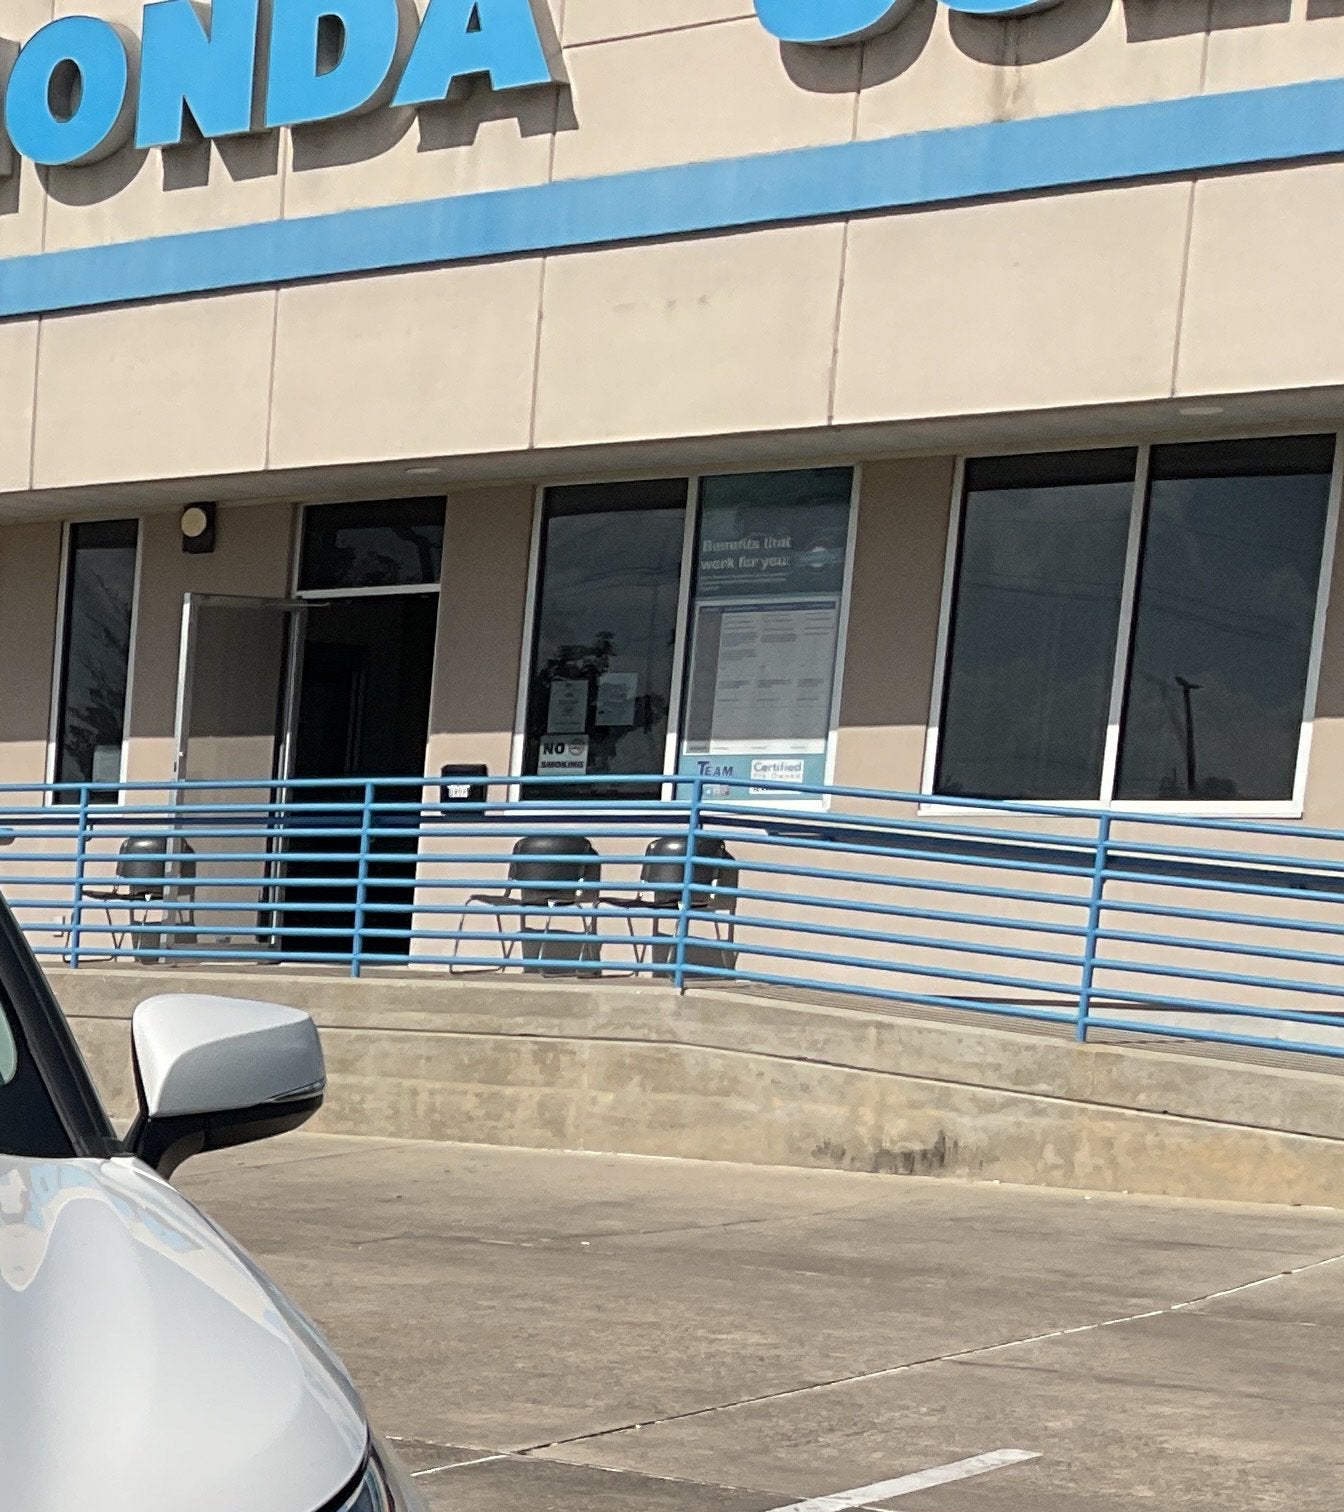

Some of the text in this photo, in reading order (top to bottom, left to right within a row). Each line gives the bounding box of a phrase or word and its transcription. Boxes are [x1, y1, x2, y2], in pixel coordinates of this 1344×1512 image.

[700, 557, 734, 570] work
[738, 555, 756, 568] for
[543, 742, 565, 755] NO
[697, 761, 734, 776] TEAM
[753, 761, 802, 772] Certified
